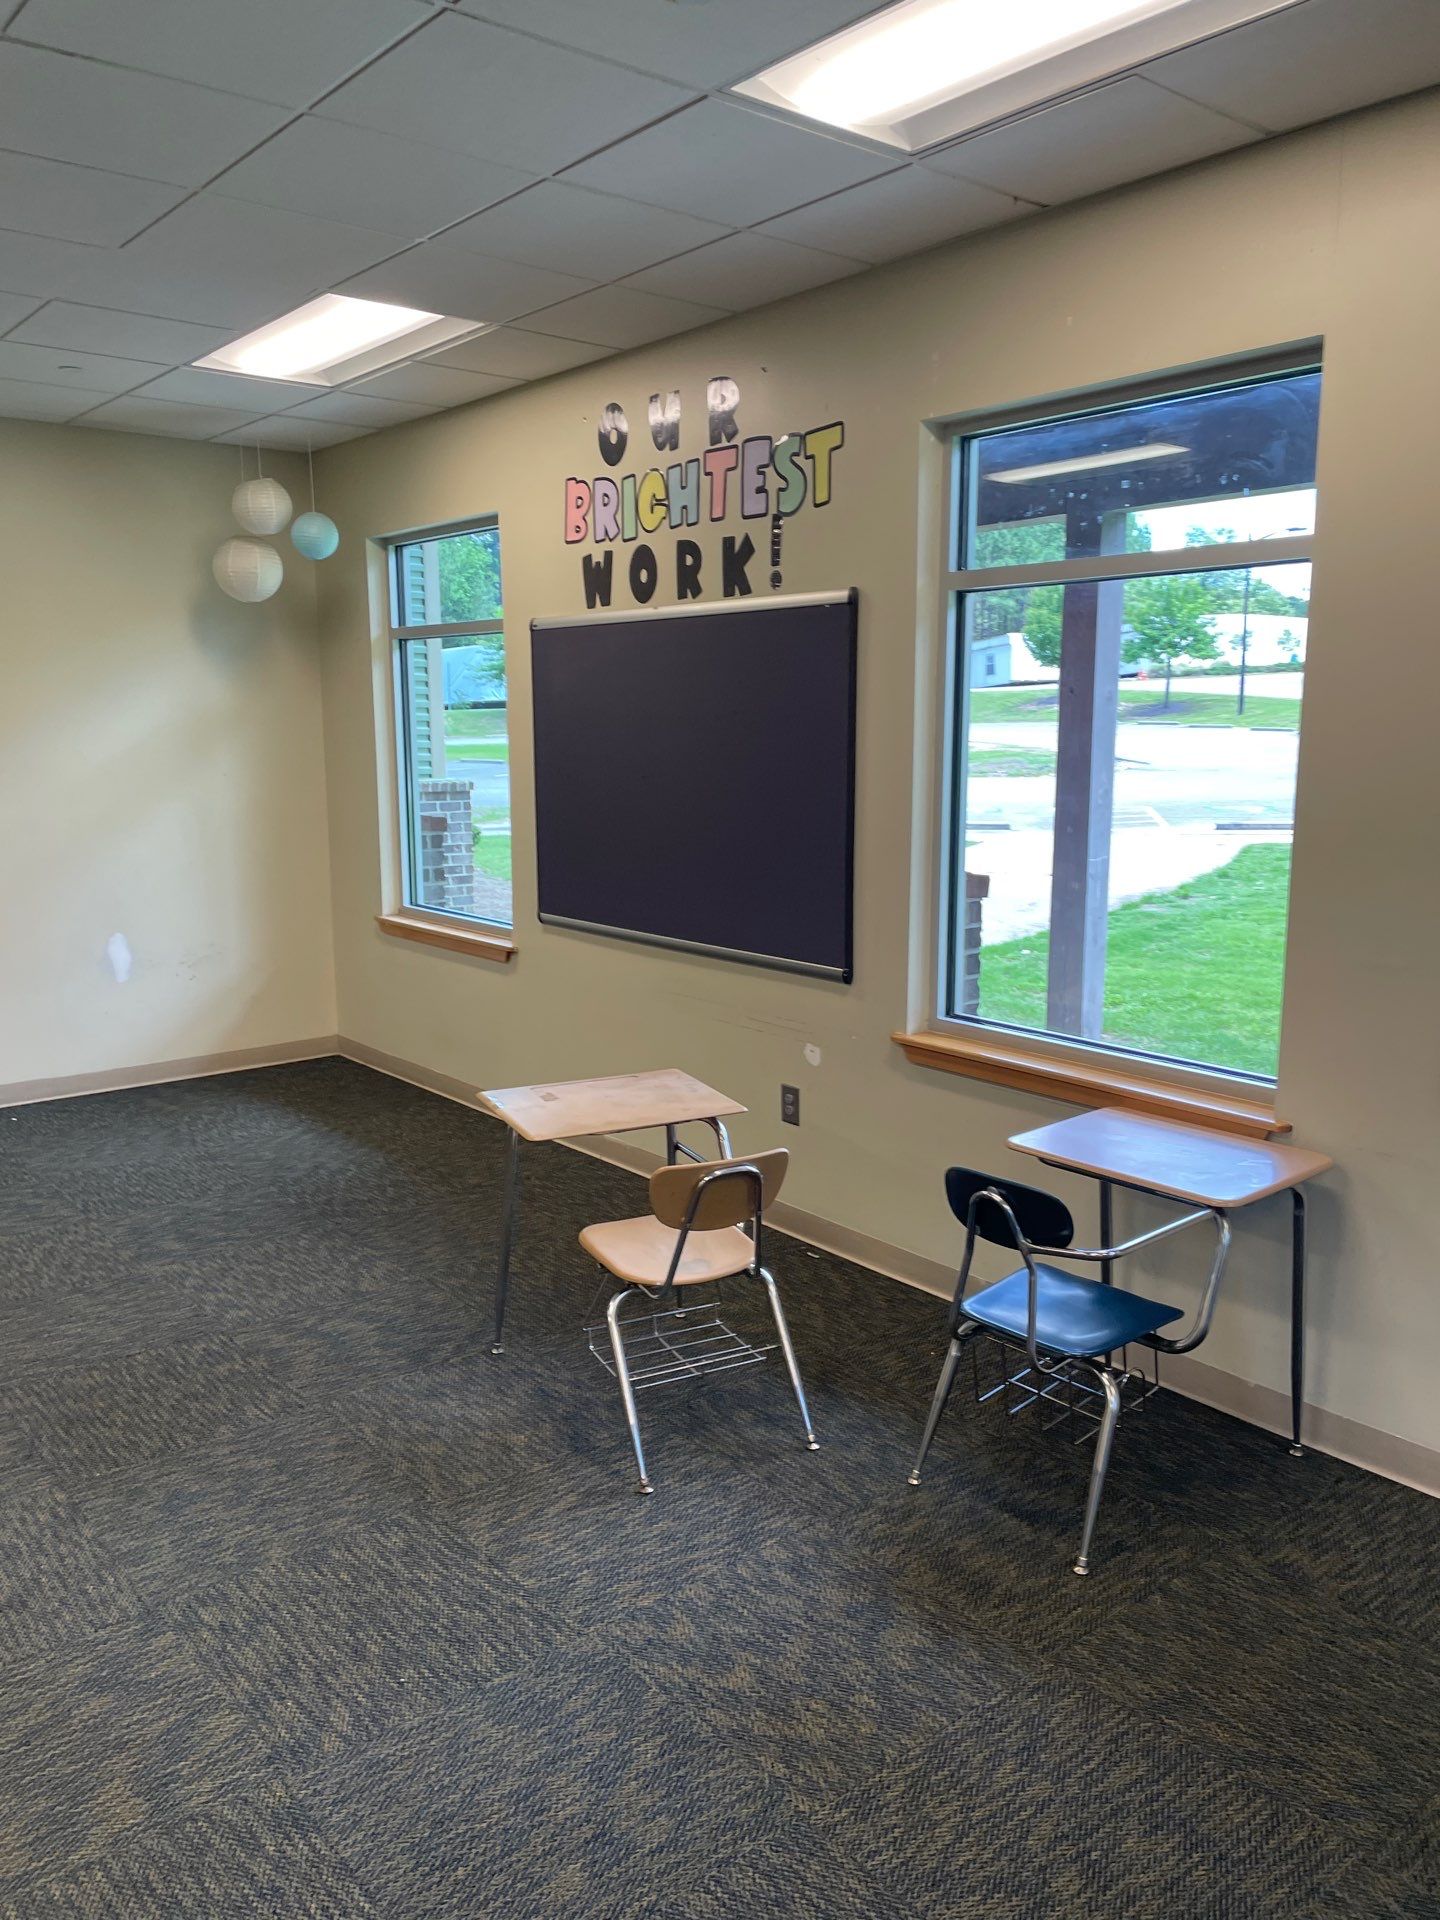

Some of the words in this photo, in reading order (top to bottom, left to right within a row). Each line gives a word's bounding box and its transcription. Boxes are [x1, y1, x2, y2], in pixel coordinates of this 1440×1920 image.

[598, 376, 740, 466] OUR
[564, 420, 844, 544] BRIGHTEST
[582, 513, 783, 609] WORK!
